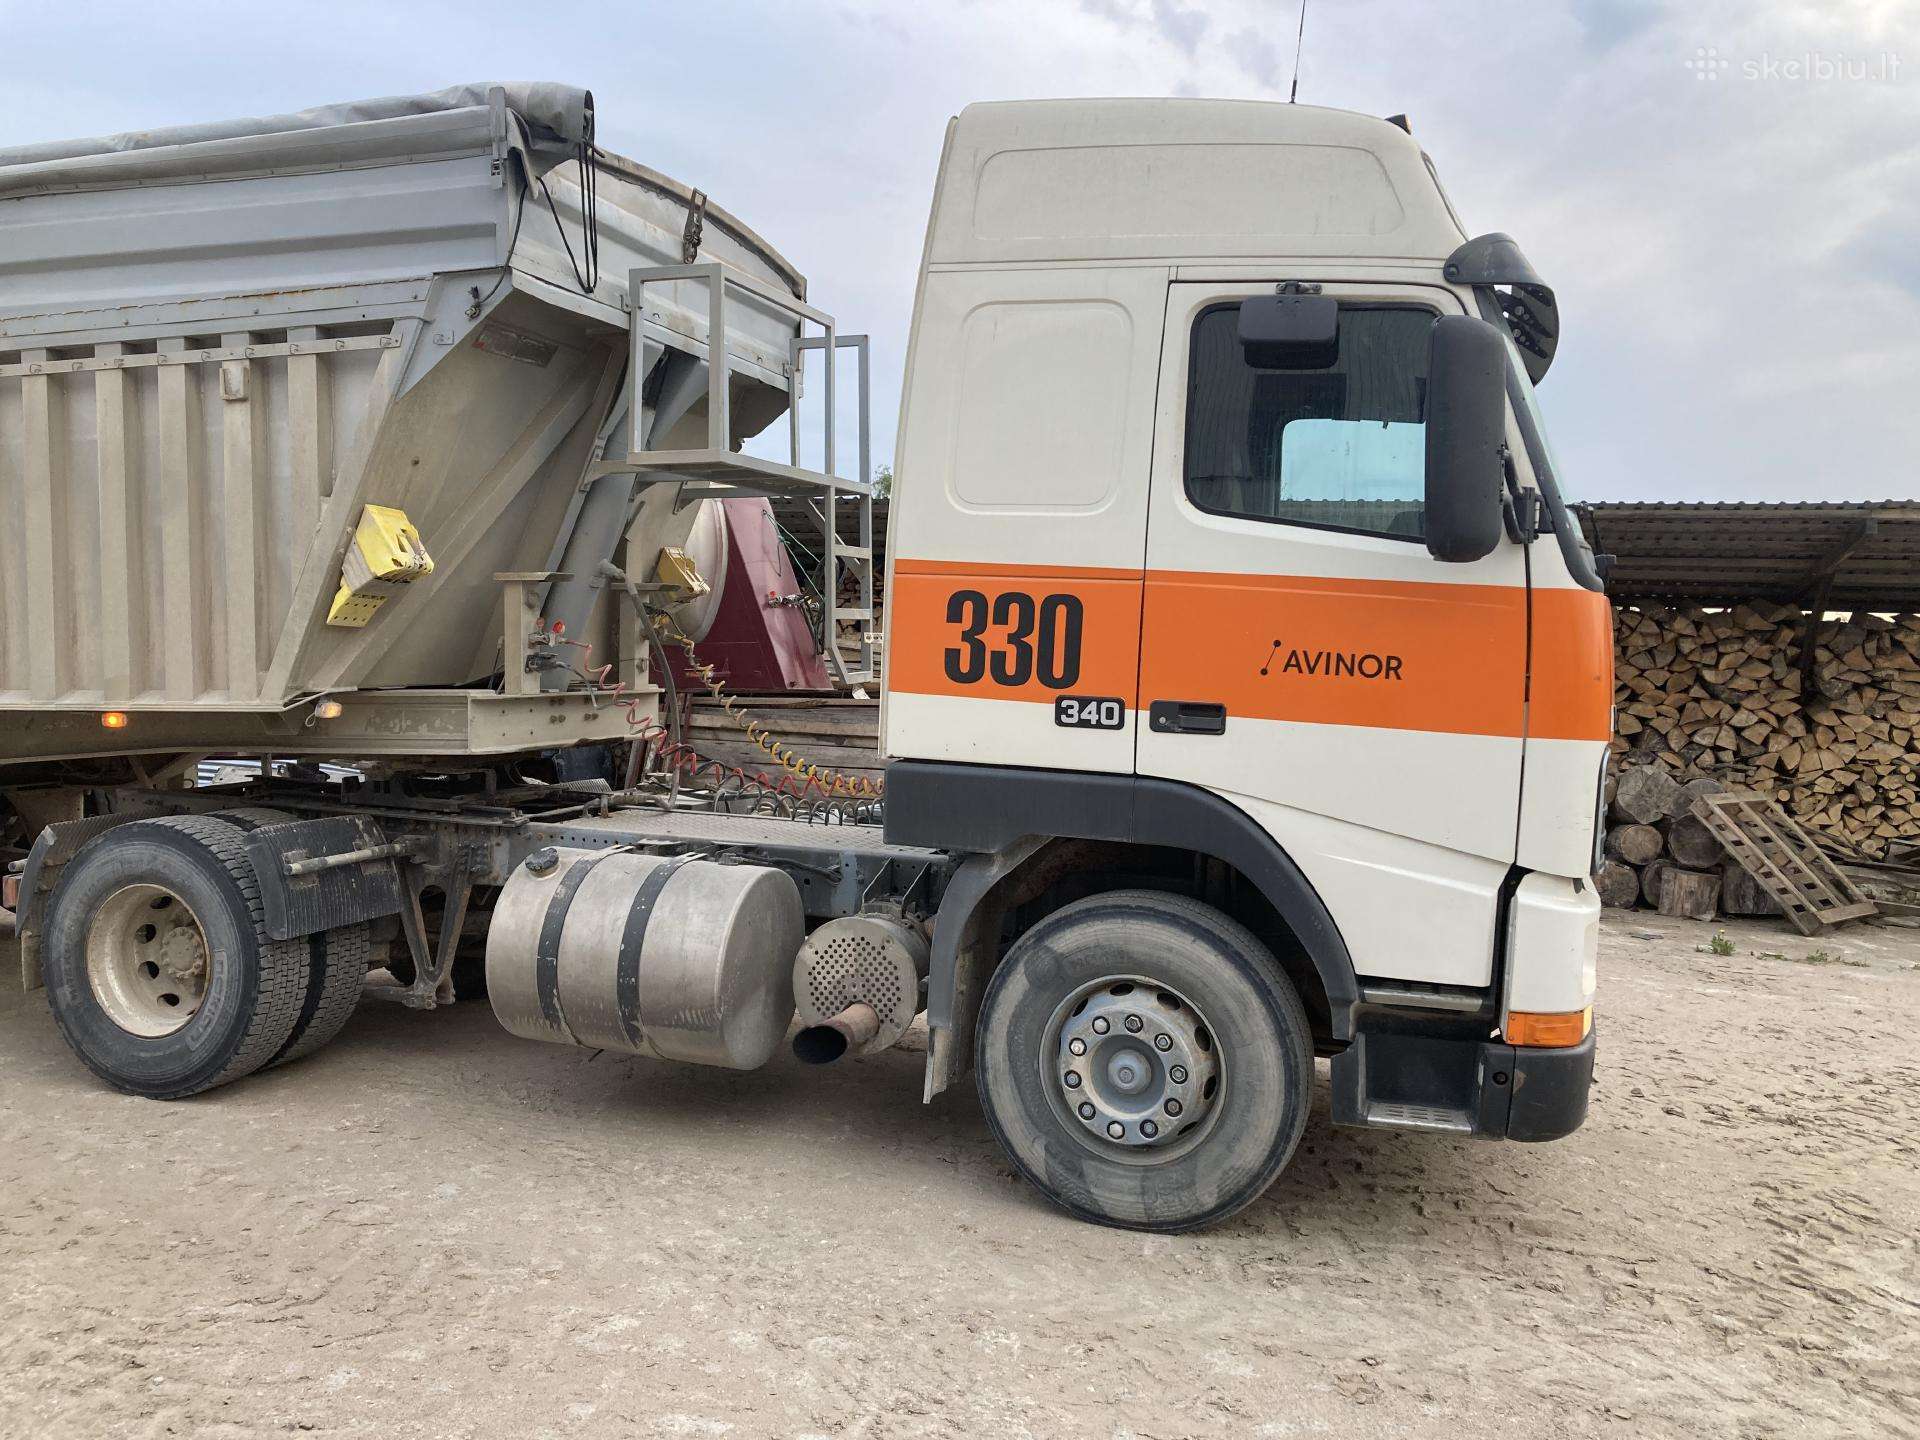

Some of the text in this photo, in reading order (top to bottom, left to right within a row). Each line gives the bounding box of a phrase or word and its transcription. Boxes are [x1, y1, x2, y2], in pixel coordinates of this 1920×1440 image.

[944, 590, 1083, 689] 330
[1282, 649, 1403, 681] AVINOR
[1060, 700, 1120, 726] 340
